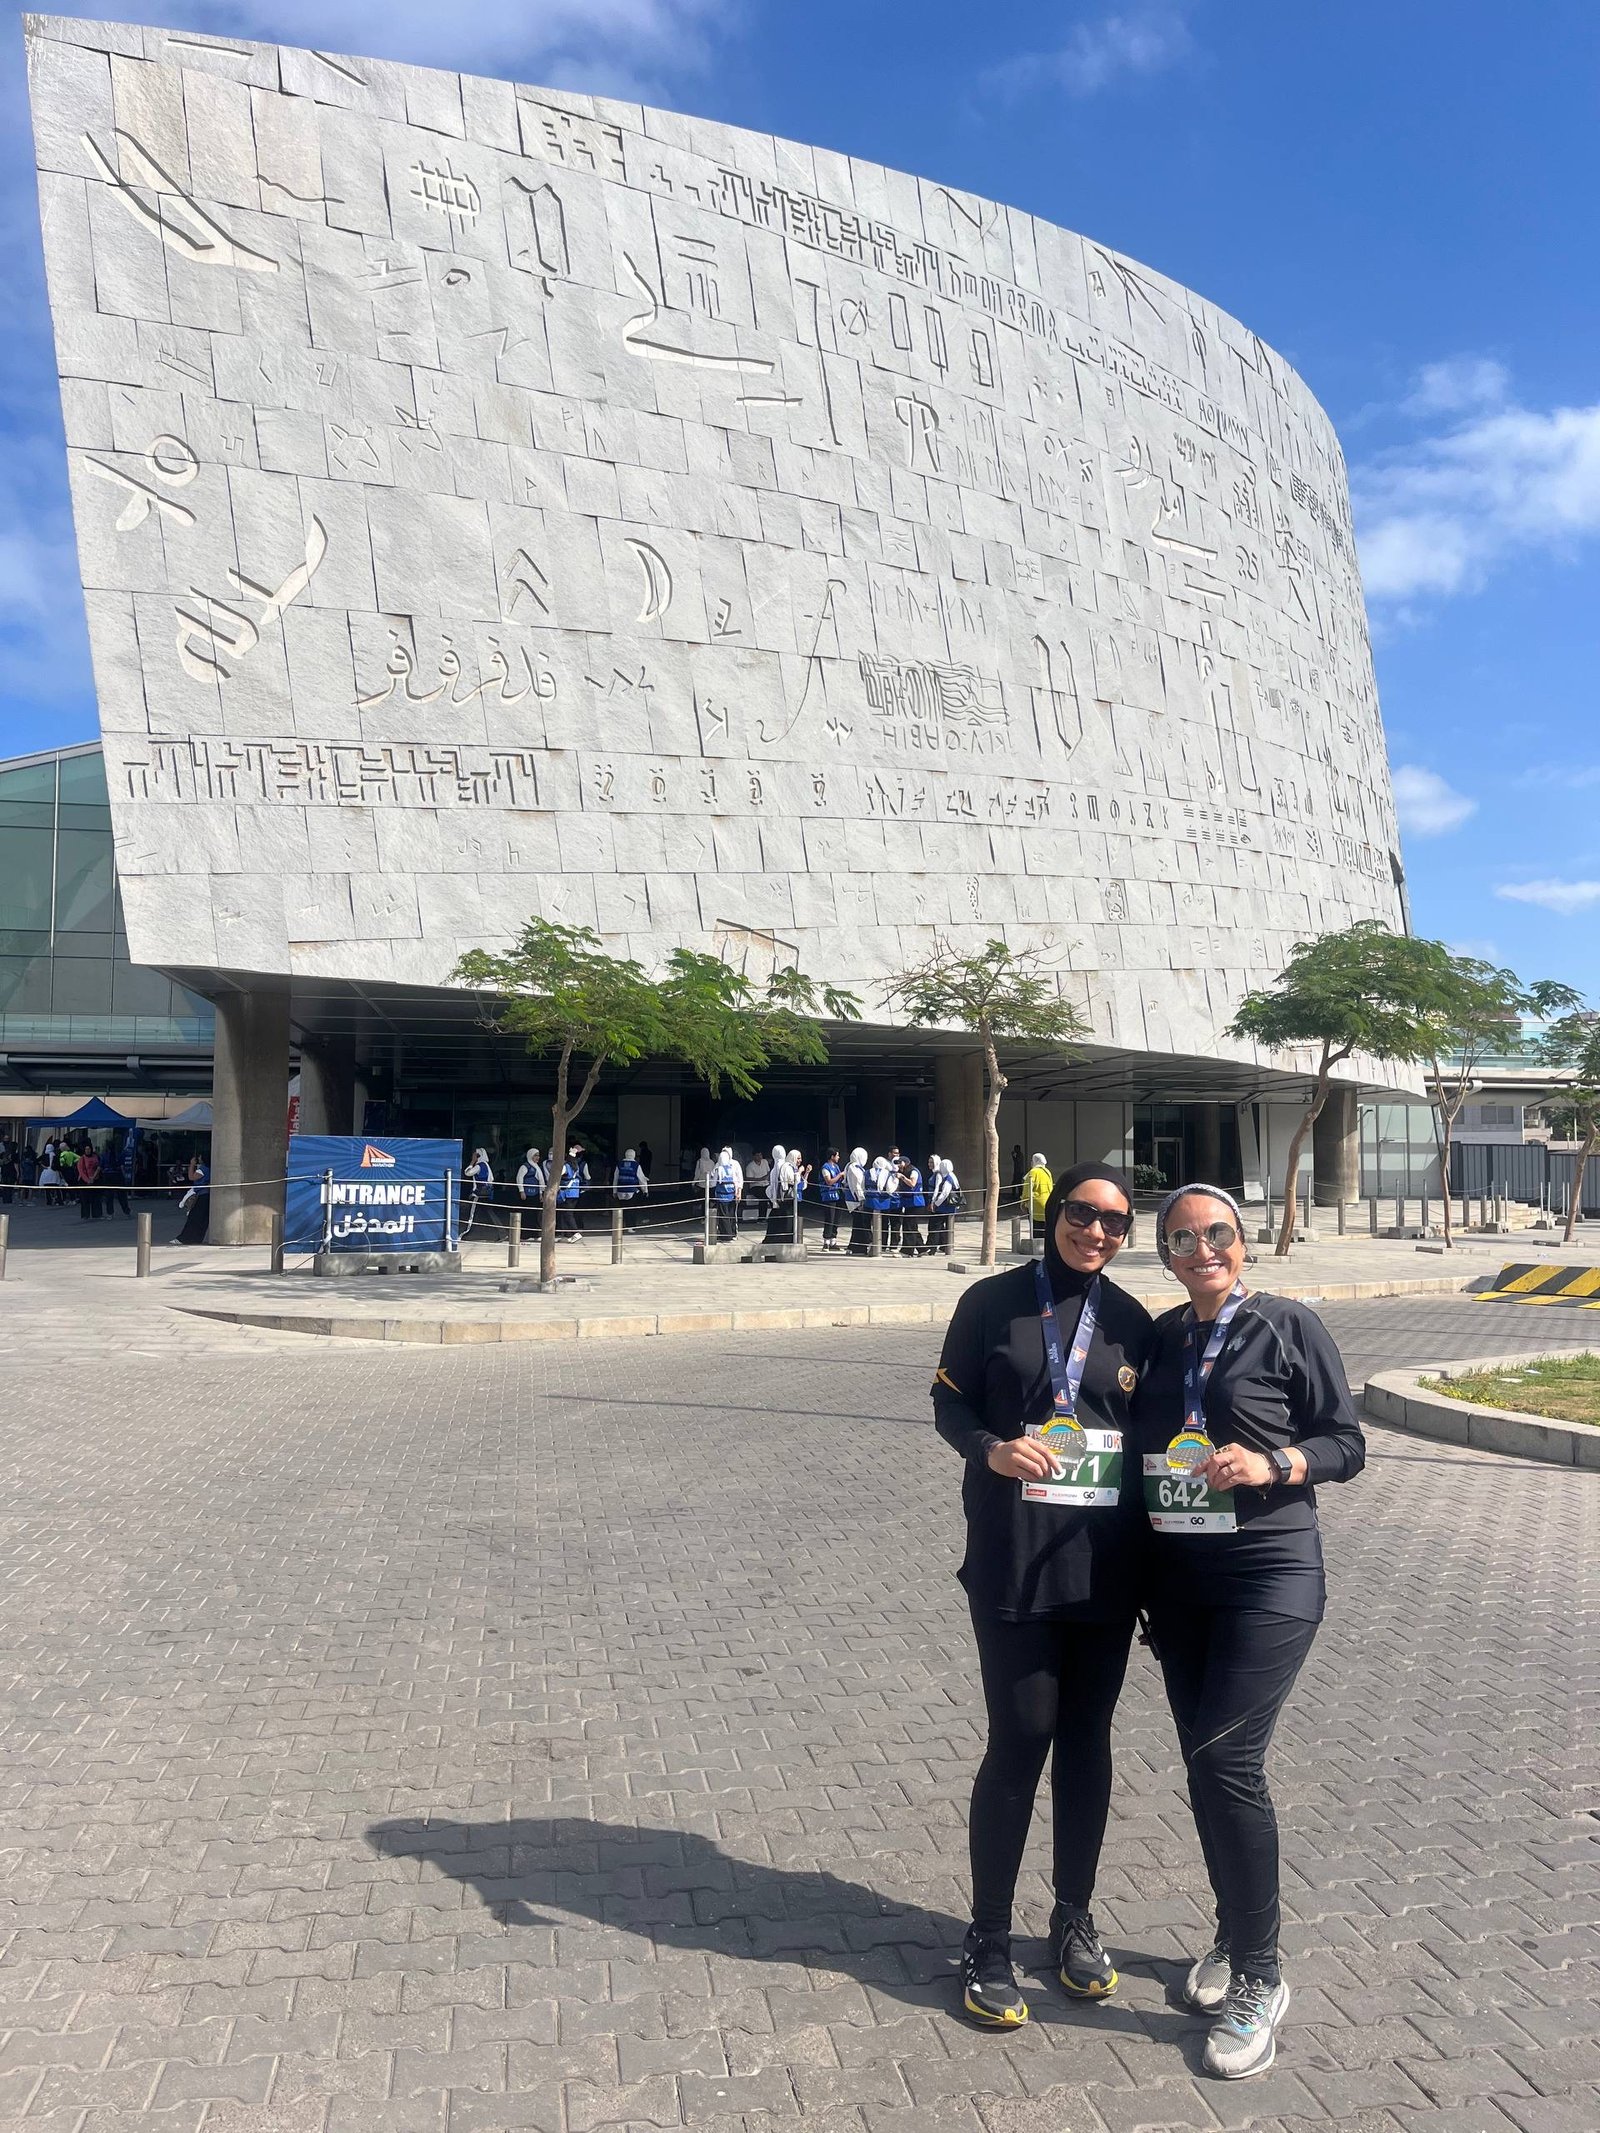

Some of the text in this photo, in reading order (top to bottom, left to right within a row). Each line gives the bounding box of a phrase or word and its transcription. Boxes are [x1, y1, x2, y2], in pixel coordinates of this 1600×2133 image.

[333, 1211, 415, 1238] المدخل
[1083, 1491, 1096, 1500] GO
[1158, 1479, 1210, 1508] 642
[1190, 1516, 1205, 1526] GO
